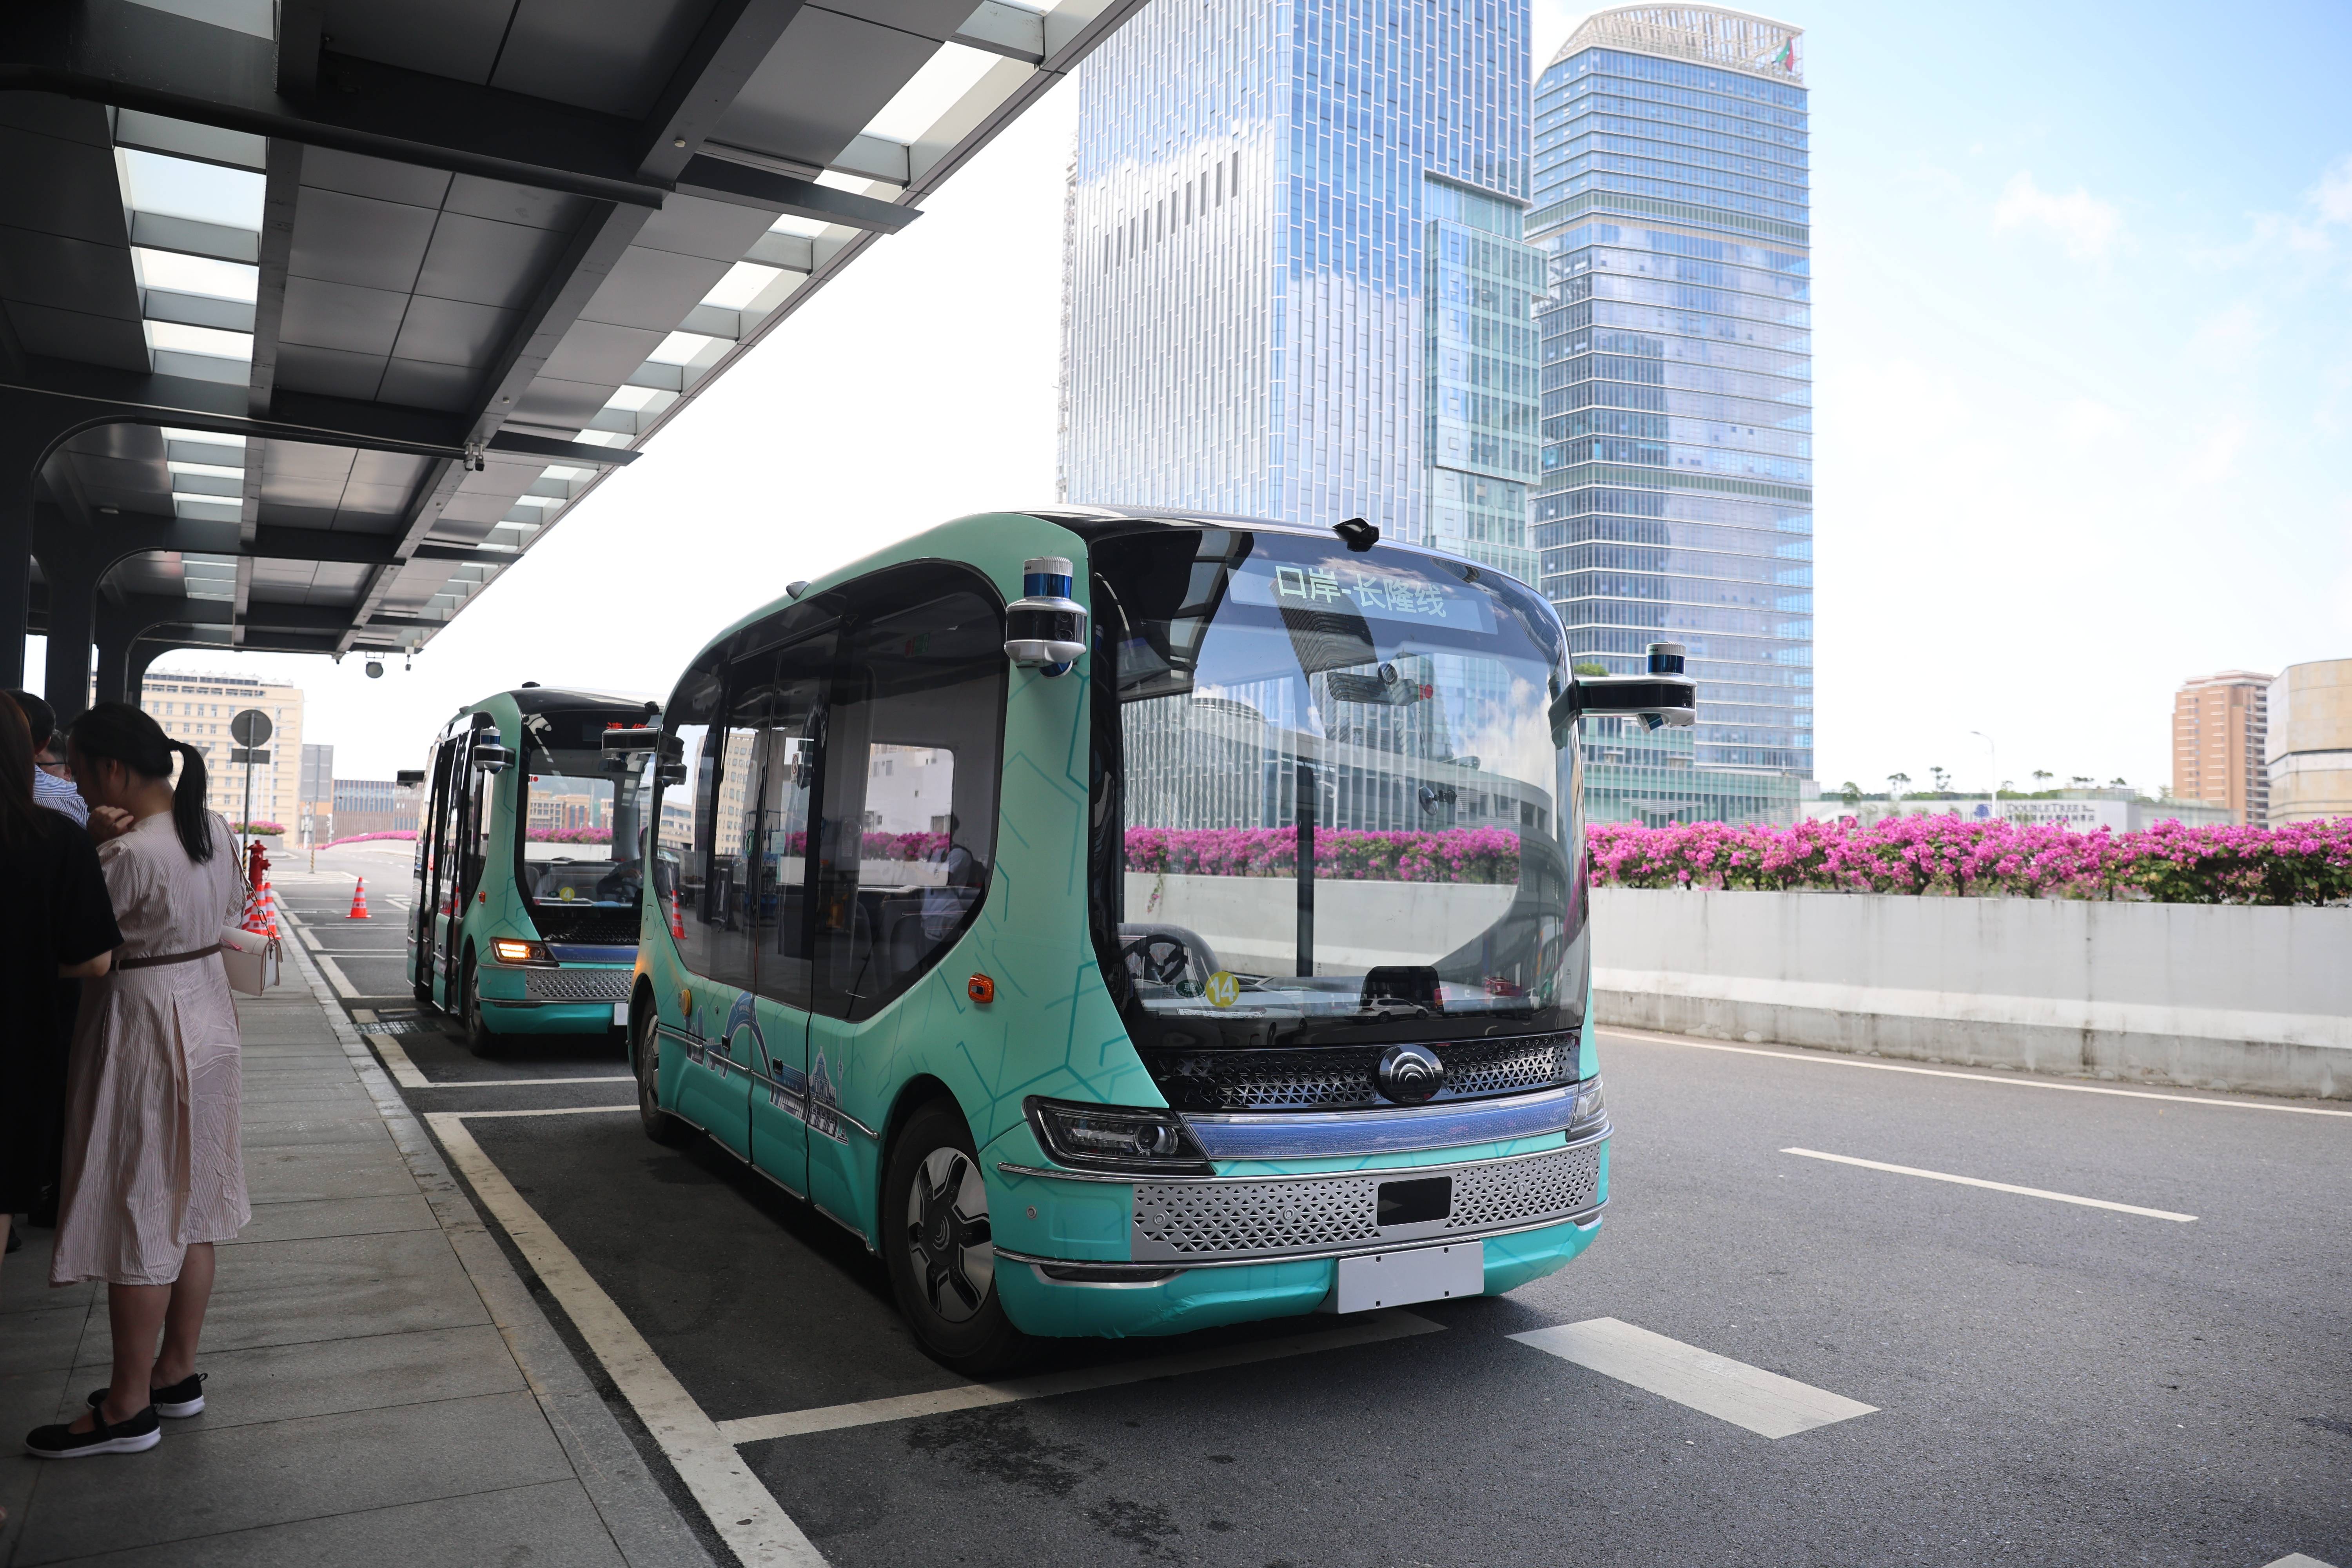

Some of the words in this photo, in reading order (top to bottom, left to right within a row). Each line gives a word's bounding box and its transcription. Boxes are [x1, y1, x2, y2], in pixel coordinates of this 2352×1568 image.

[1275, 566, 1446, 617] 口岸-长隆线
[563, 889, 571, 900] 4
[1209, 976, 1236, 1003] 14
